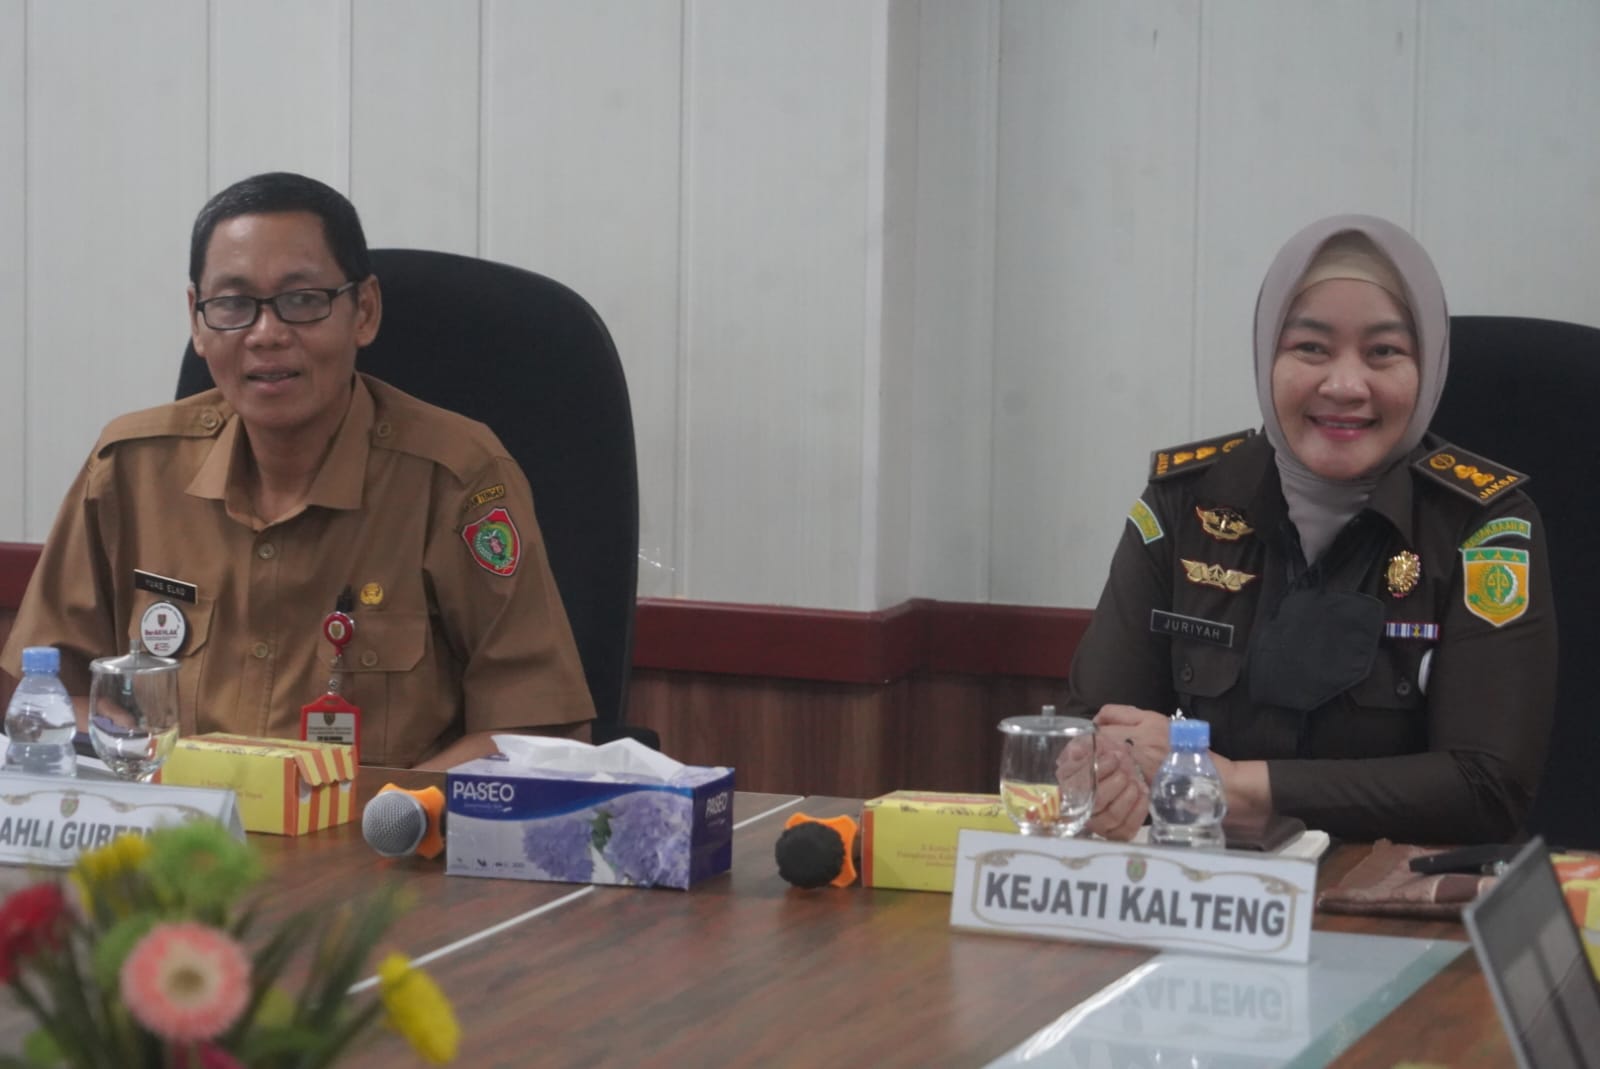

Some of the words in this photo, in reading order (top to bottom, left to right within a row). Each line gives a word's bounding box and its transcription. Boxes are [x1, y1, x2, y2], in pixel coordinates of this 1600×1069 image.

[1480, 475, 1518, 499] JAKSA
[1163, 618, 1220, 640] JURIYAH
[453, 780, 514, 802] PASEO
[705, 792, 728, 817] PASEO
[0, 816, 54, 849] AHLI
[984, 871, 1108, 919] KEJATI
[1119, 884, 1286, 937] KALTENG
